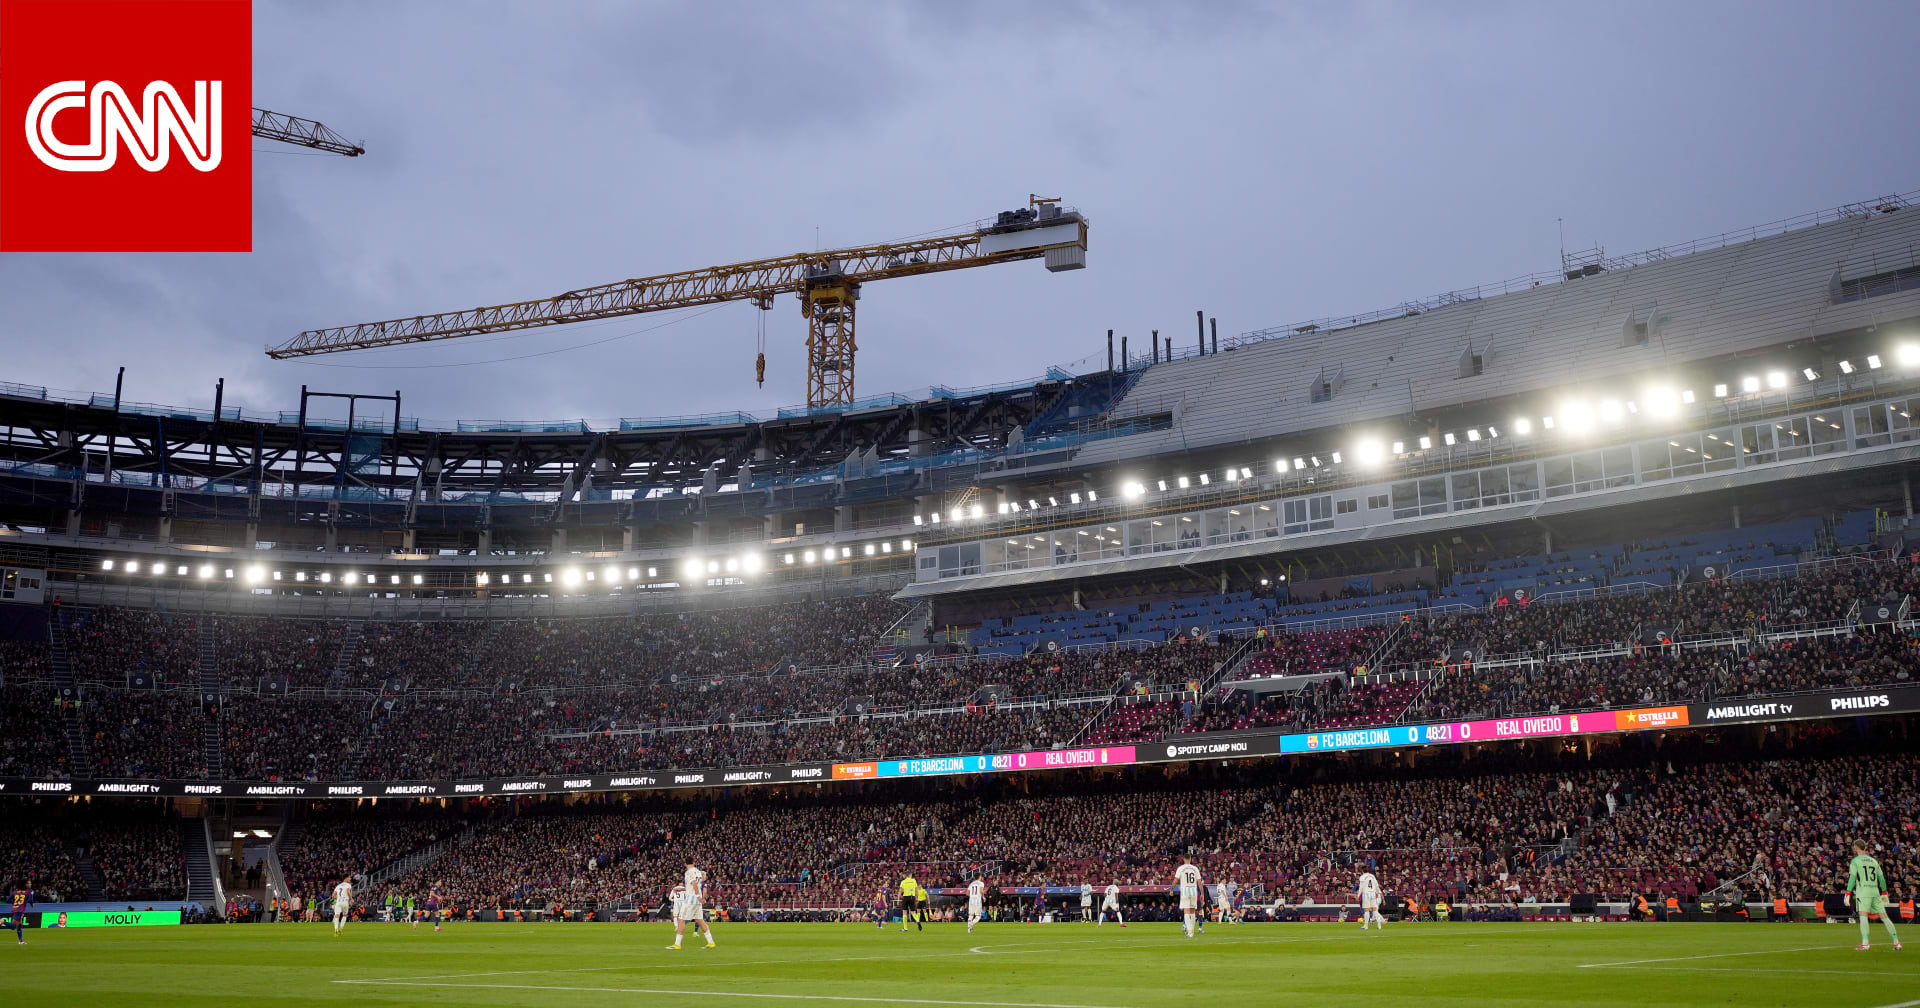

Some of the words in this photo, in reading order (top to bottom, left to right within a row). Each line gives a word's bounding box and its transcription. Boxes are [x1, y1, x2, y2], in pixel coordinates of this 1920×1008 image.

[1831, 695, 1889, 710] PHILIPS
[1707, 703, 1777, 719] AMBILIGHT
[1780, 704, 1793, 714] tv
[1638, 711, 1678, 722] ESTRELLA
[1322, 735, 1334, 747] FC
[1336, 730, 1390, 747] BARCELONA
[1408, 727, 1418, 742] 0
[1426, 725, 1452, 740] 48:21
[1460, 723, 1471, 738] 0
[1496, 720, 1522, 735] REAL
[1523, 717, 1562, 733] OVIEDO
[1178, 745, 1207, 755] SPOTIFY
[1208, 743, 1230, 753] CAMP
[1231, 742, 1247, 751] NOU
[910, 761, 921, 773] FC
[921, 759, 964, 772] BARCELONA
[978, 756, 986, 769] 0
[1018, 754, 1026, 767] 0
[1046, 753, 1064, 765] REAL
[1066, 750, 1095, 763] OVIEDO
[723, 772, 763, 781] AMBILIGHT
[764, 771, 772, 780] tv
[791, 768, 822, 778] PHILIPS
[563, 779, 592, 788] PHILIPS
[610, 777, 648, 786] AMBILIGHT
[648, 777, 656, 785] tv
[674, 774, 704, 784] PHILIPS
[31, 782, 72, 792] PHILIPS
[98, 784, 149, 793] AMBILIGHT
[151, 785, 160, 793] tv
[184, 785, 222, 794] PHILIPS
[246, 786, 295, 795] AMBILIGHT
[296, 787, 305, 795] tv
[328, 786, 363, 795] PHILIPS
[385, 785, 427, 794] AMBILIGHT
[428, 785, 436, 793] tv
[455, 784, 484, 792] PHILIPS
[502, 782, 538, 791] AMBILIGHT
[539, 782, 546, 790] tv
[1185, 872, 1195, 884] 16
[1862, 865, 1876, 882] 13
[1367, 879, 1373, 889] 4
[971, 885, 978, 896] 11
[14, 894, 26, 905] 23
[104, 914, 142, 925] MOLIY
